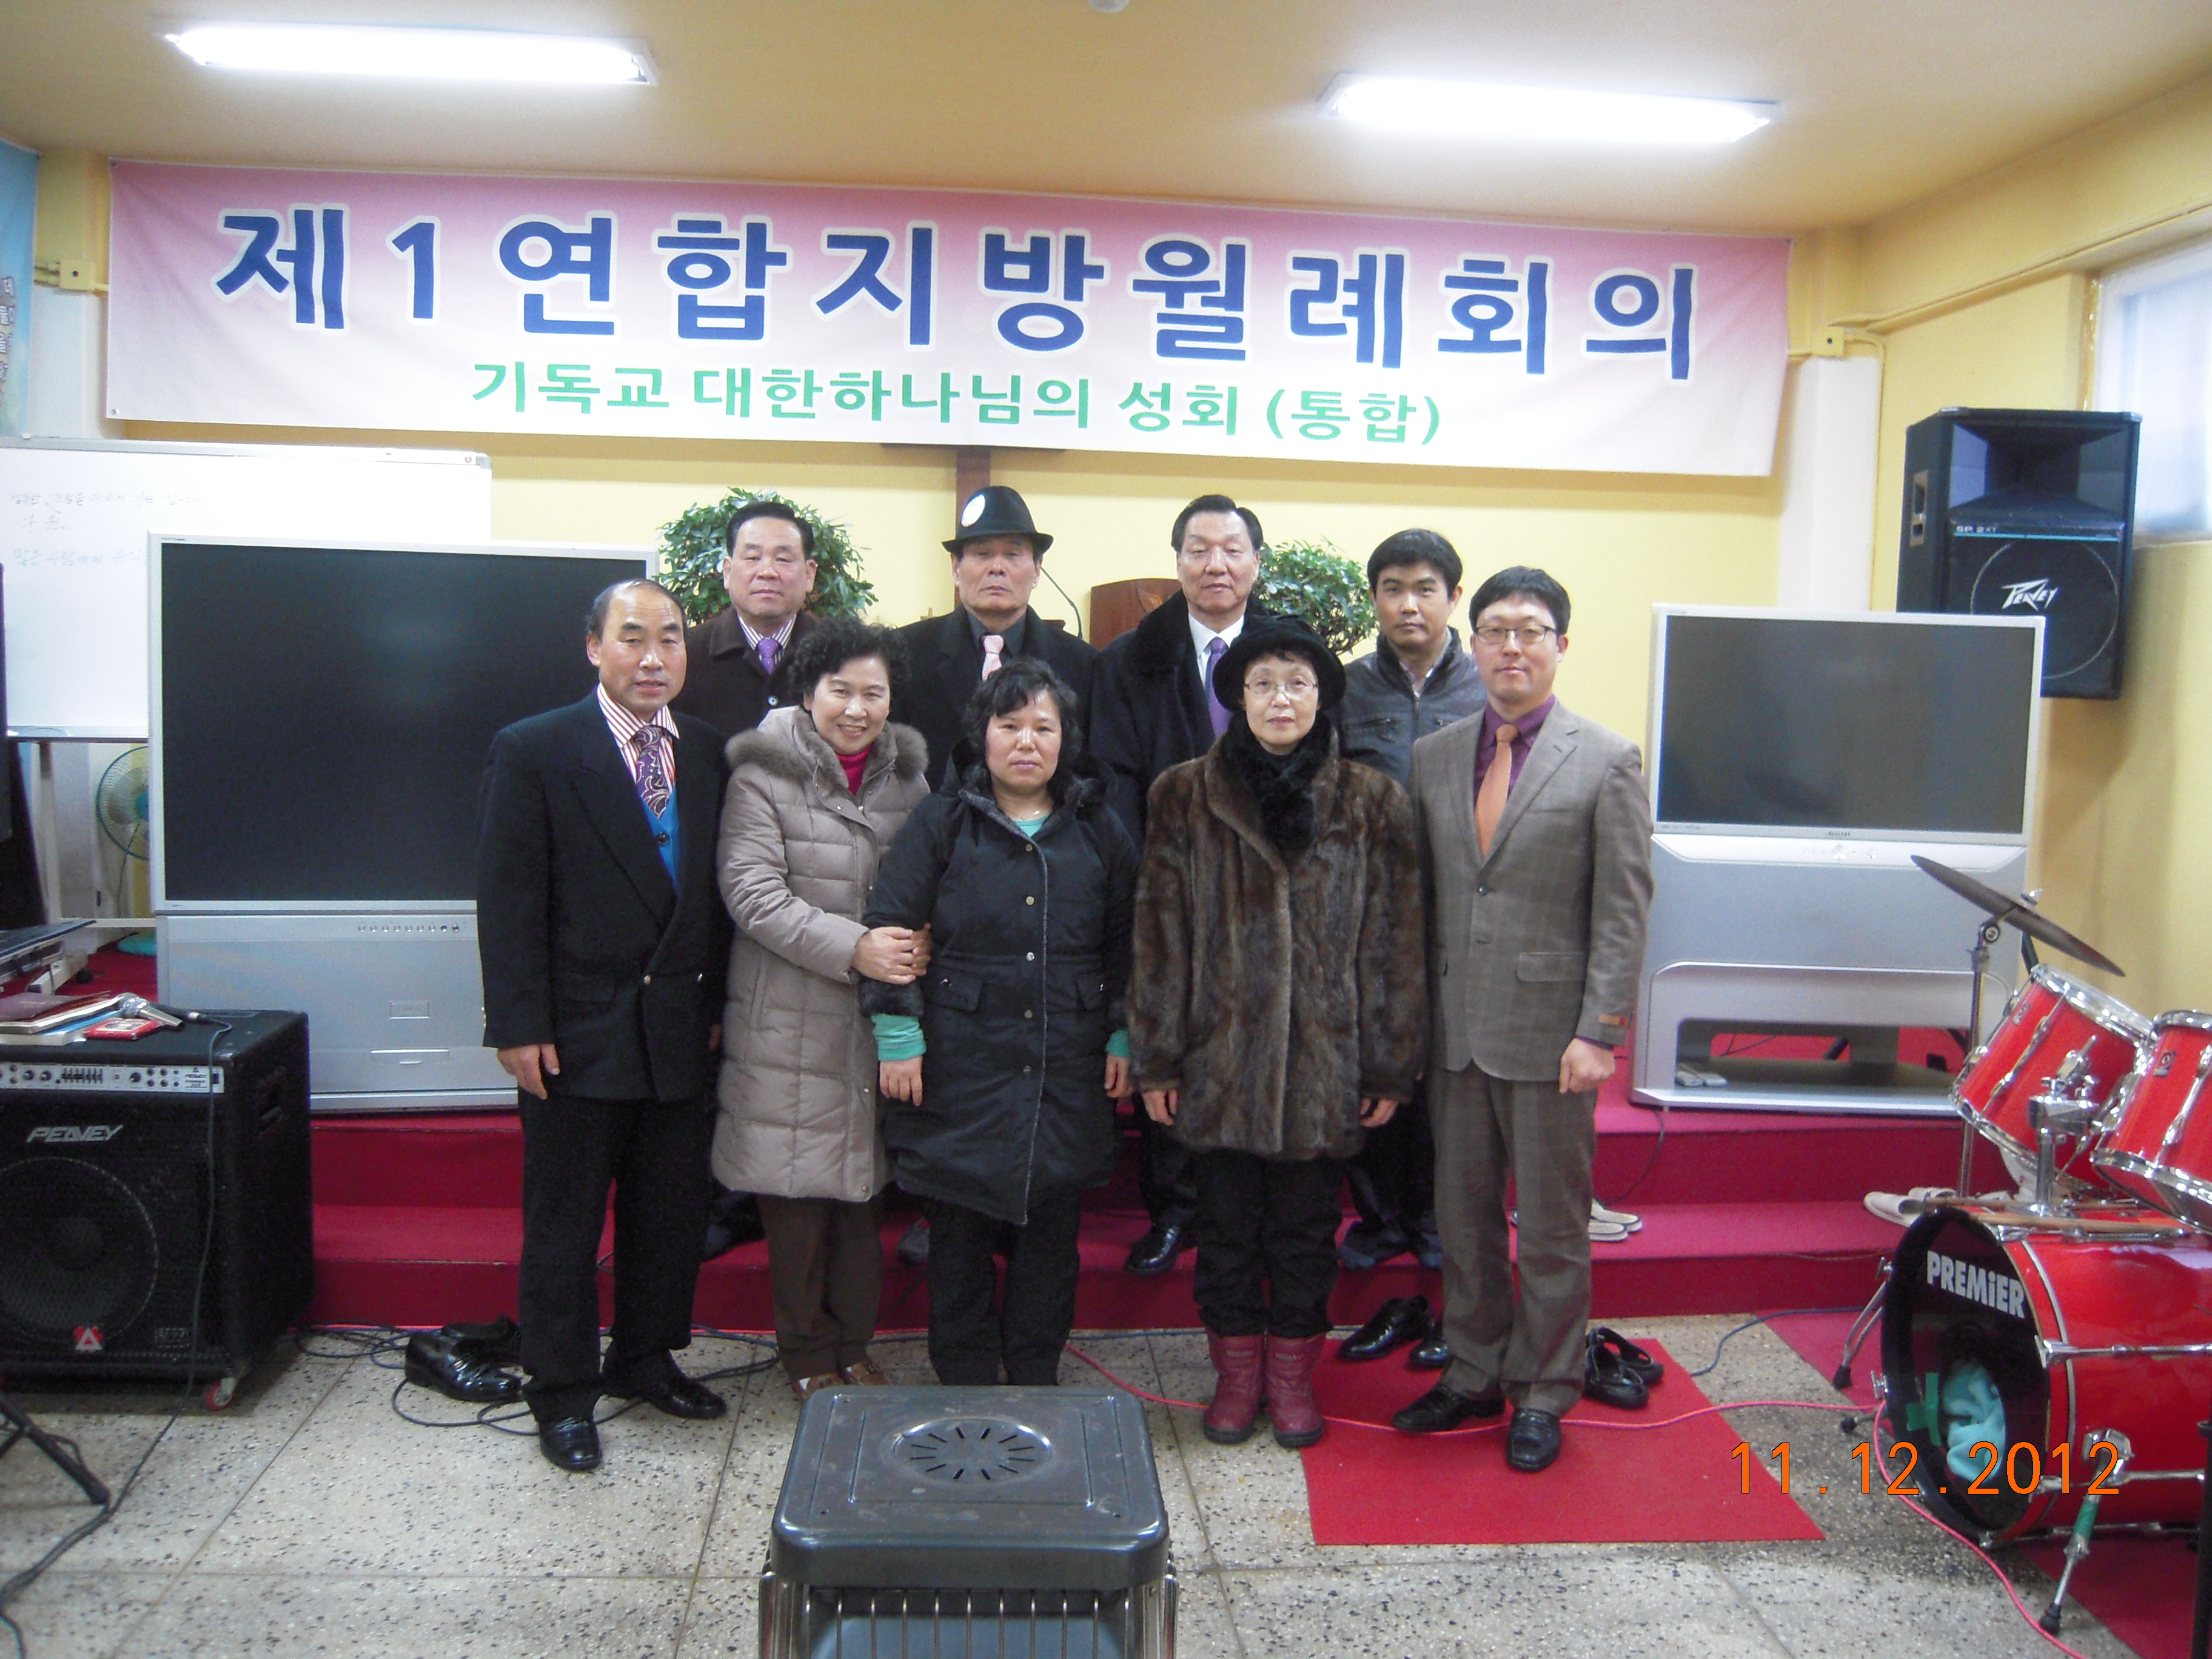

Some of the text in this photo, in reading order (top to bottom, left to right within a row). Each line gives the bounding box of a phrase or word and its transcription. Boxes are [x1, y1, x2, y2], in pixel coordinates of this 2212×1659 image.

[473, 361, 1440, 444] 기독교 대한하나님의 성회 (통합)
[27, 1125, 124, 1143] PEAVEY
